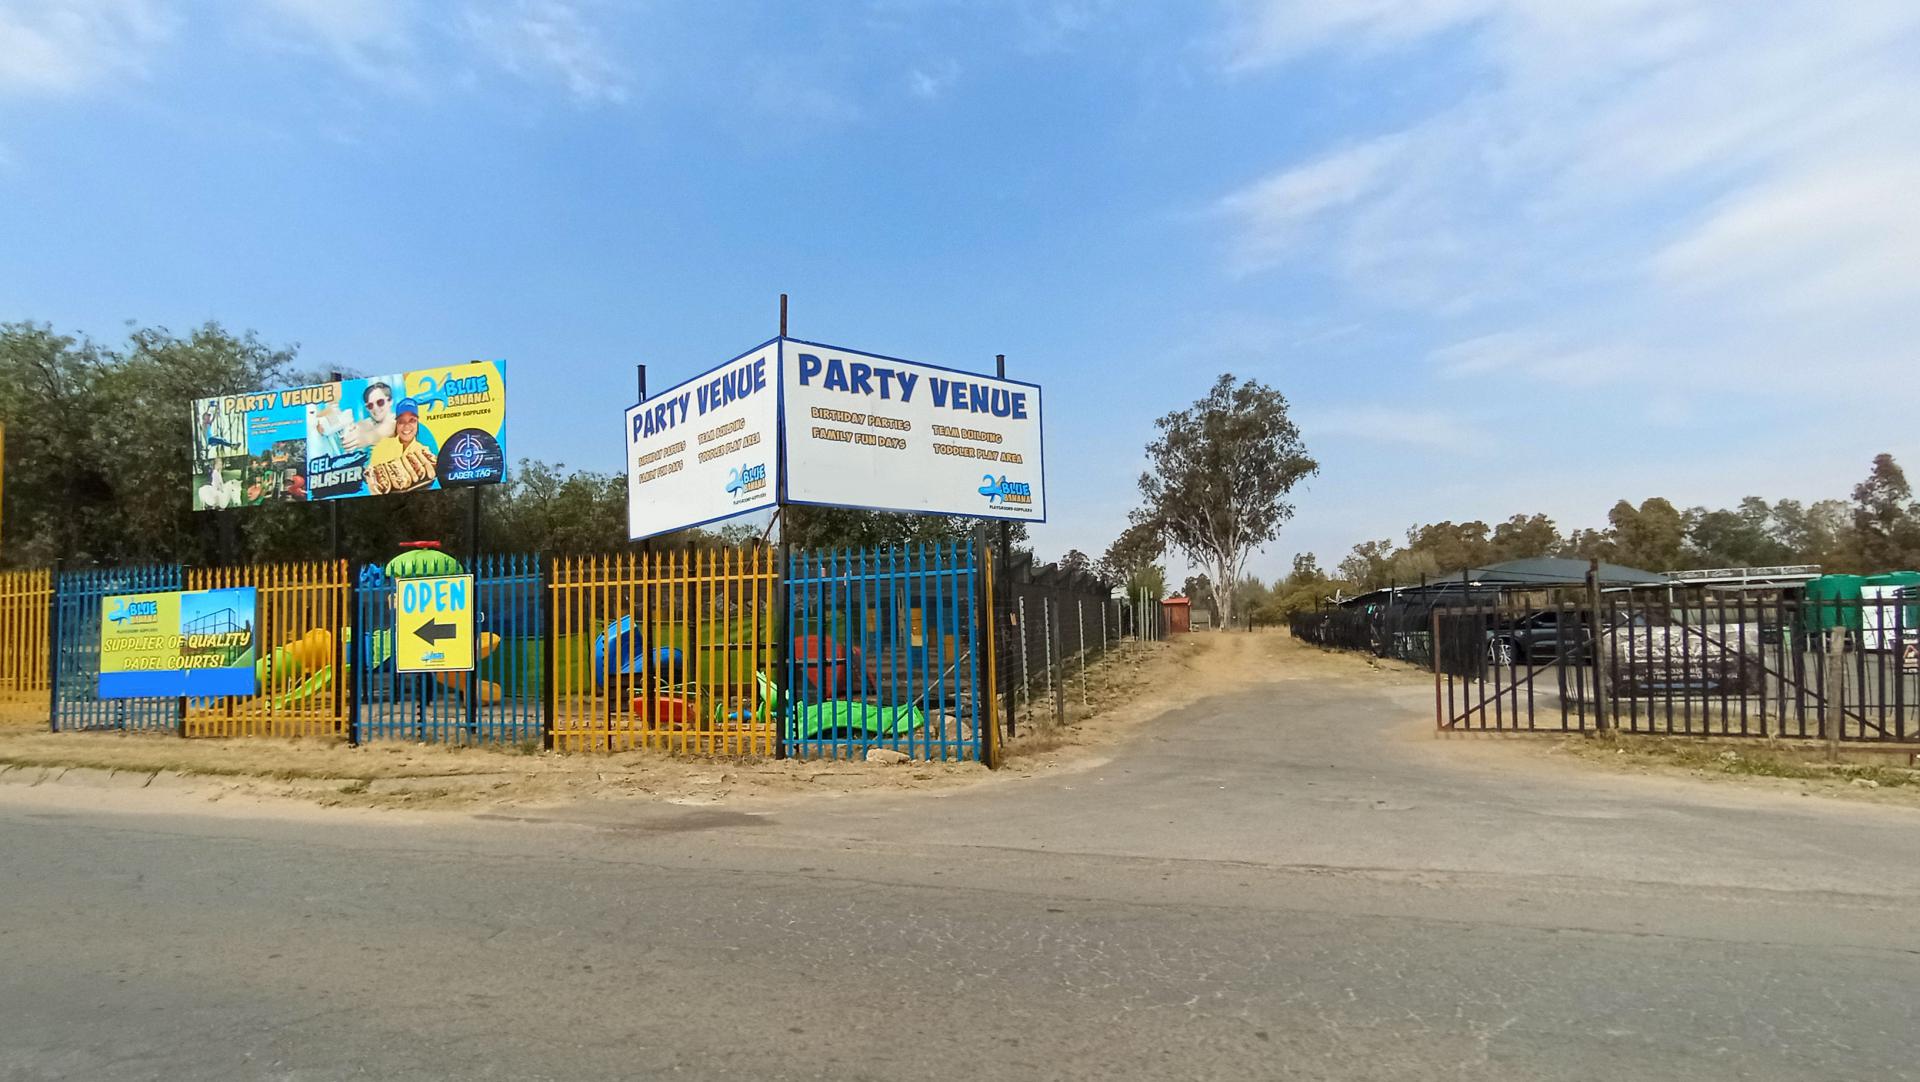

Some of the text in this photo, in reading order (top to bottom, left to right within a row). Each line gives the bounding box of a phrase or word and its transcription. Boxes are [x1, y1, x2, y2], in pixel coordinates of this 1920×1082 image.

[444, 375, 489, 397] BLUE
[797, 353, 1028, 420] PARTY VENUE
[224, 384, 335, 415] PARTY VENUE
[447, 392, 490, 407] BANANA
[633, 356, 766, 444] PARTY VENUE
[811, 407, 912, 431] BIRTHDAY PARTIES
[697, 418, 745, 445] TEAM BUILDING
[812, 427, 907, 450] FAMILY FUN DAYS
[932, 425, 1003, 444] TEAM BUILDING
[697, 432, 761, 464] TODDLER PLAY AREA
[933, 443, 1023, 464] TODDLER PLAY AREA
[309, 455, 333, 474] GEL
[475, 469, 491, 479] TAG
[742, 463, 766, 484] BLUE
[309, 466, 363, 490] BLASTER
[1000, 481, 1031, 496] BLUE
[403, 579, 465, 614] OPEN
[129, 600, 158, 616] BLUE
[104, 631, 251, 652] SUPPLIER OF QUALITY
[123, 654, 225, 670] PADEL COURTS!
